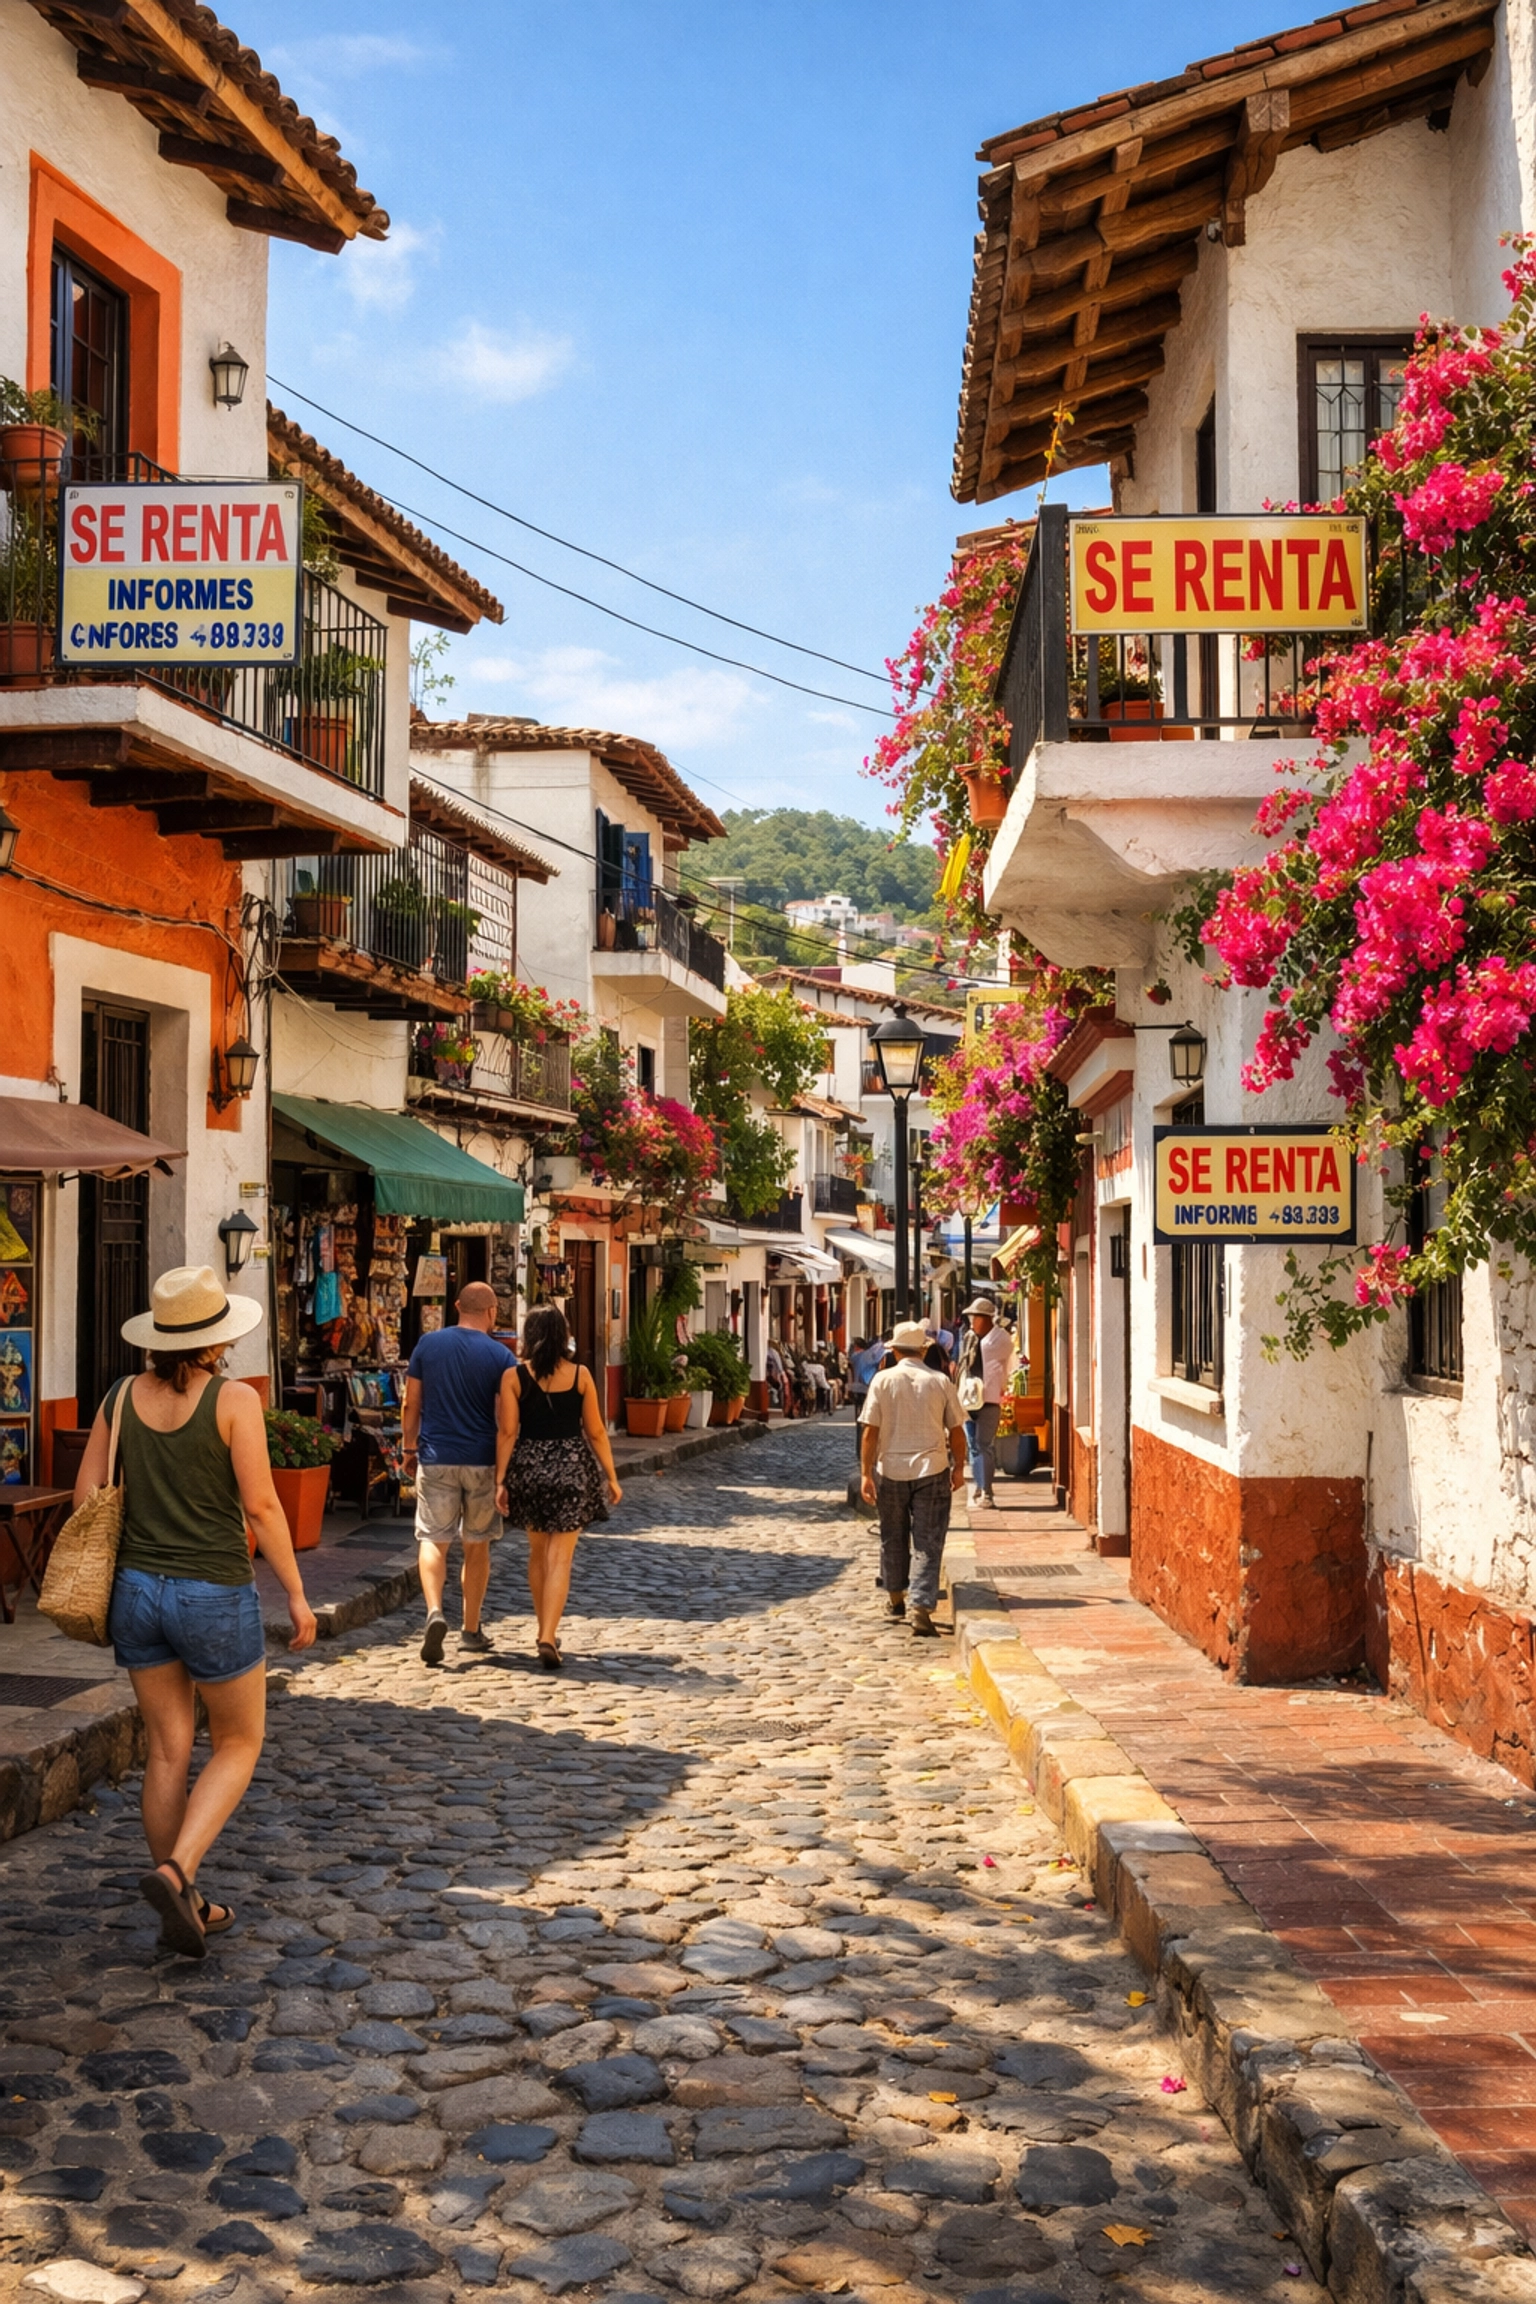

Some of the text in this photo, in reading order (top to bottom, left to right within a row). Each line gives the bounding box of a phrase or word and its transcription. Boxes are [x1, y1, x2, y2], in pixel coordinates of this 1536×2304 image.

[70, 504, 288, 563] SE RENTA
[108, 578, 254, 611] INFORMES
[1085, 538, 1357, 614] SE RENTA
[1168, 1146, 1341, 1195] SE RENTA
